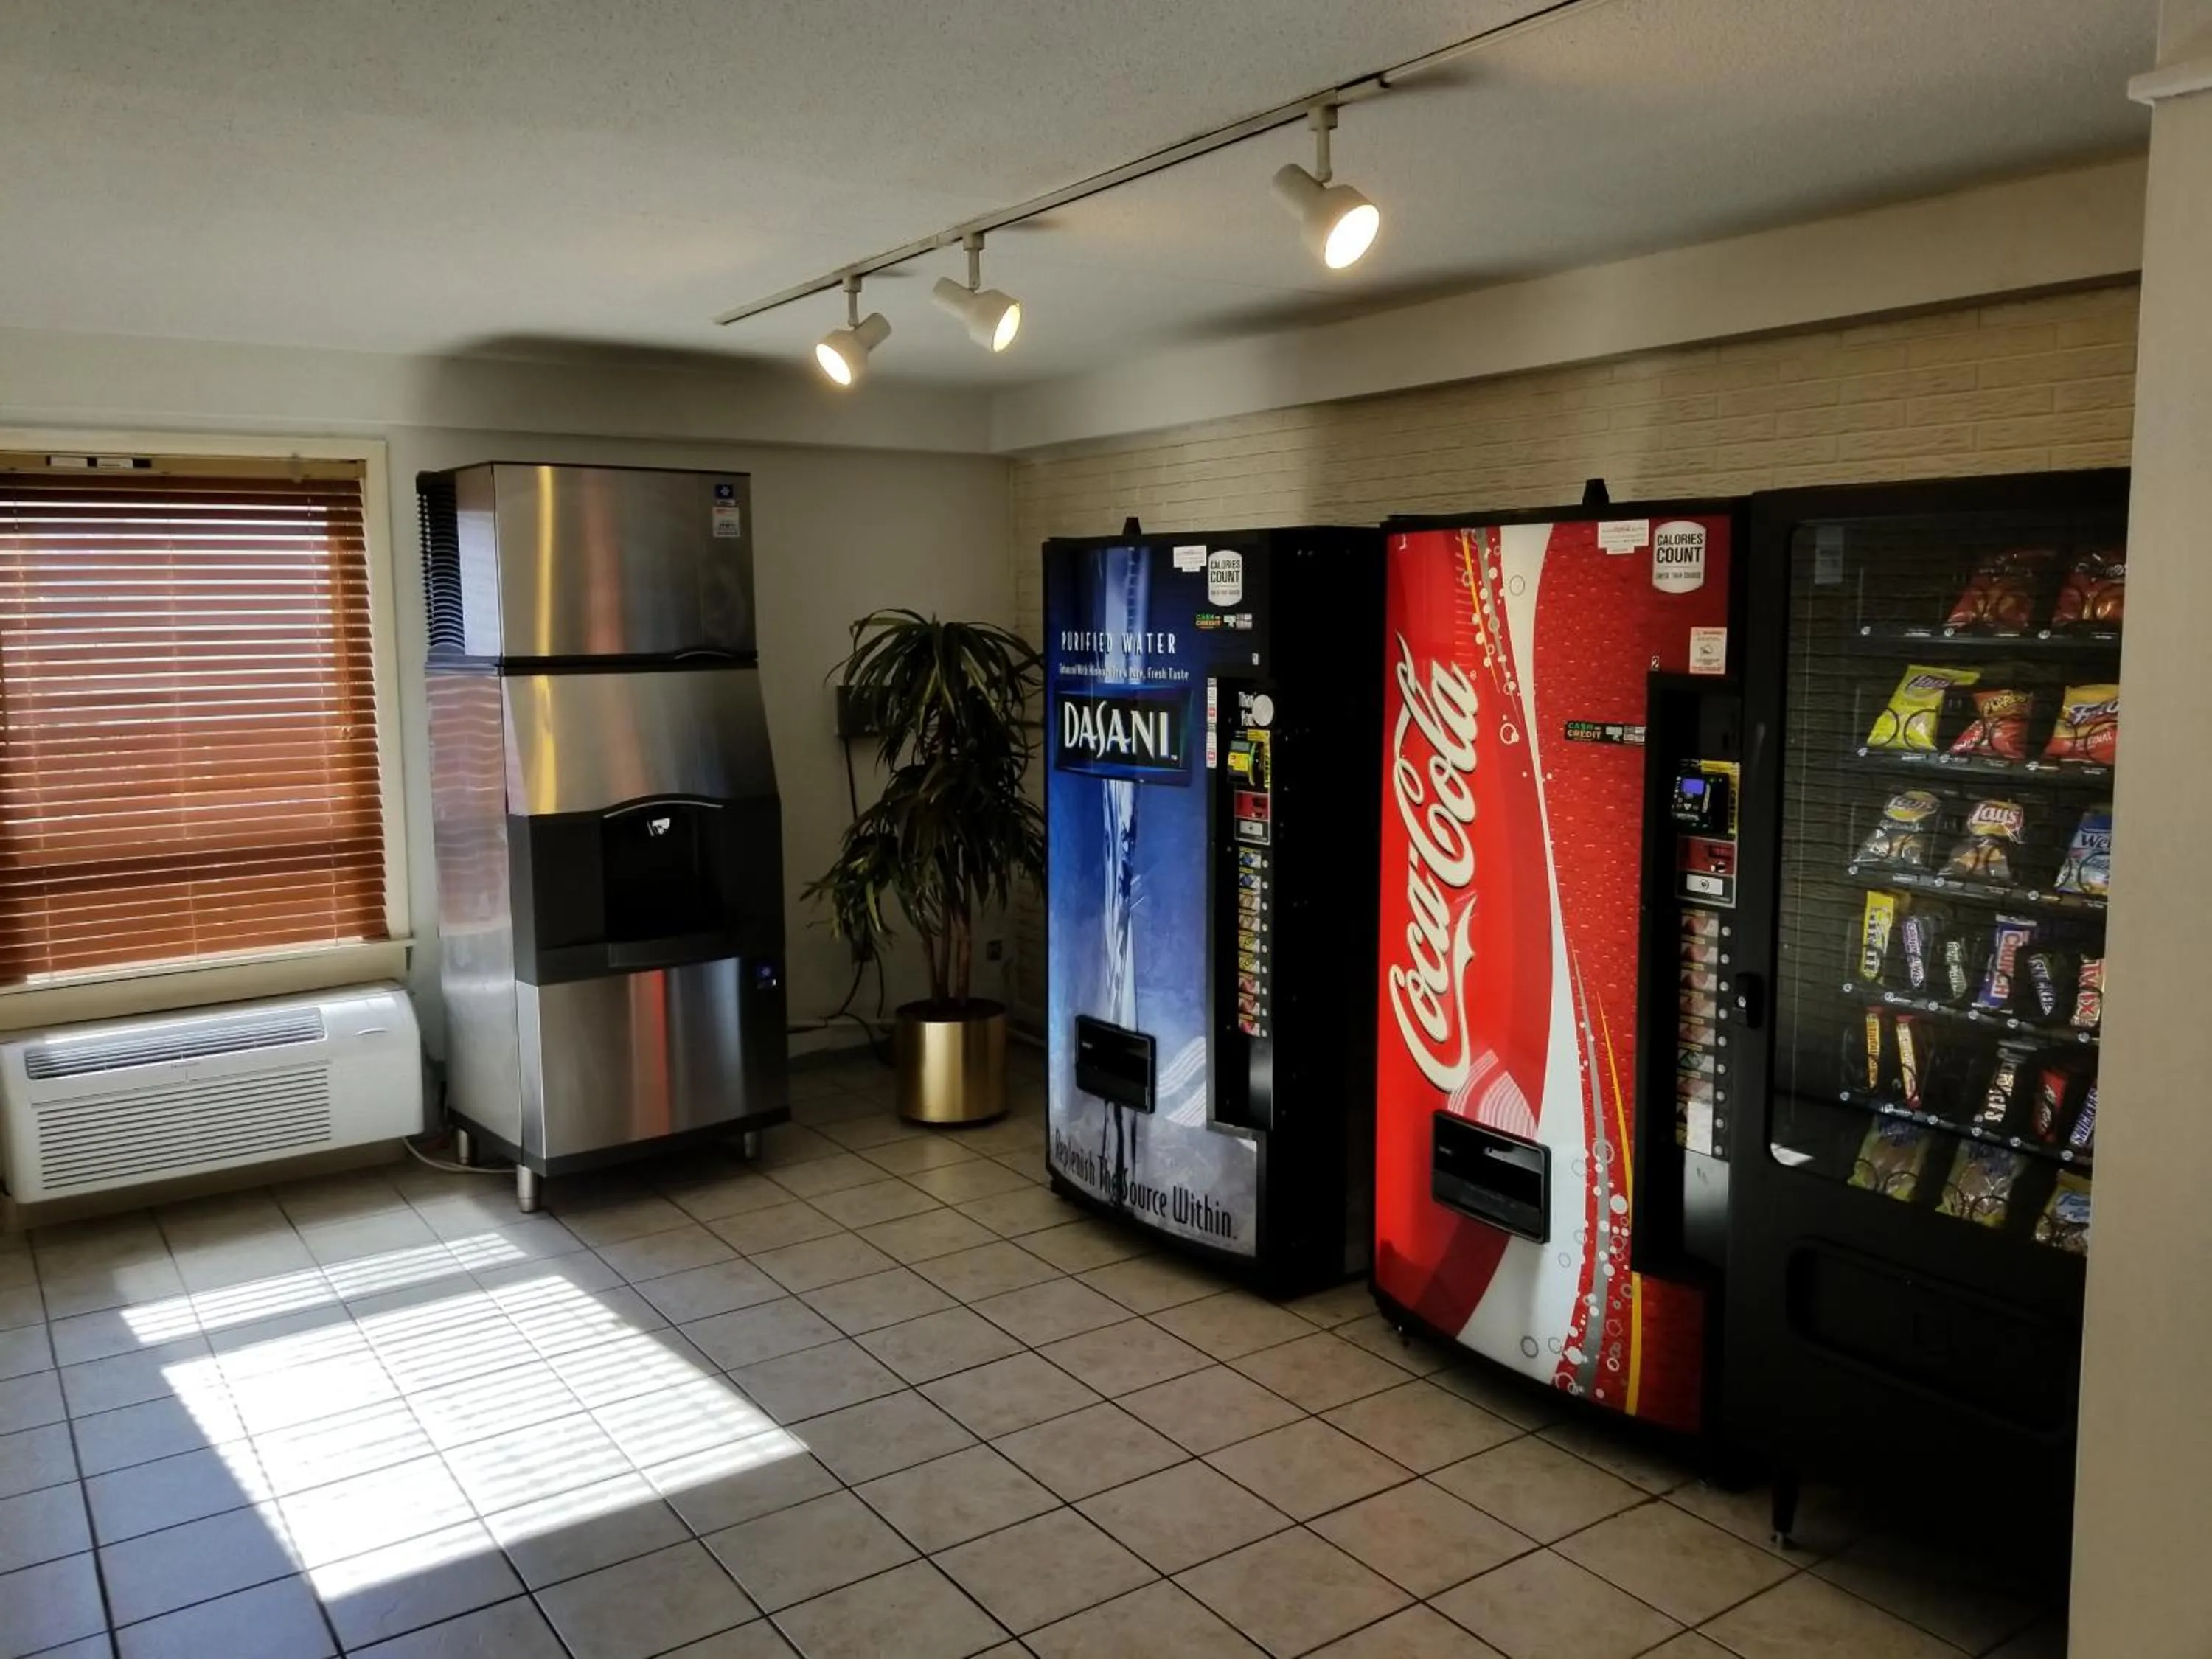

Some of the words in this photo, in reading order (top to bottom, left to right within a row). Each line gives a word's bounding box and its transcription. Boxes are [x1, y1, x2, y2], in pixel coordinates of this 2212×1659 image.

[1657, 532, 1703, 546] CALORIES
[1656, 546, 1703, 563] COUNT
[1210, 560, 1240, 570] CALORIES
[1210, 570, 1240, 583] COUNT
[1061, 630, 1113, 653] PURIFIED
[1121, 632, 1177, 654] WATER
[1147, 667, 1167, 680] Fresh
[1168, 667, 1189, 682] Taste
[1064, 700, 1169, 759] DASANI
[1567, 729, 1602, 740] CREDIT
[1388, 630, 1478, 1094] Coca-Cola
[1992, 933, 2021, 998] CRUNCH
[2079, 959, 2102, 1015] TWIX
[1055, 1127, 1095, 1186] Replenish
[1119, 1167, 1167, 1218] Source
[1172, 1185, 1232, 1239] Within
